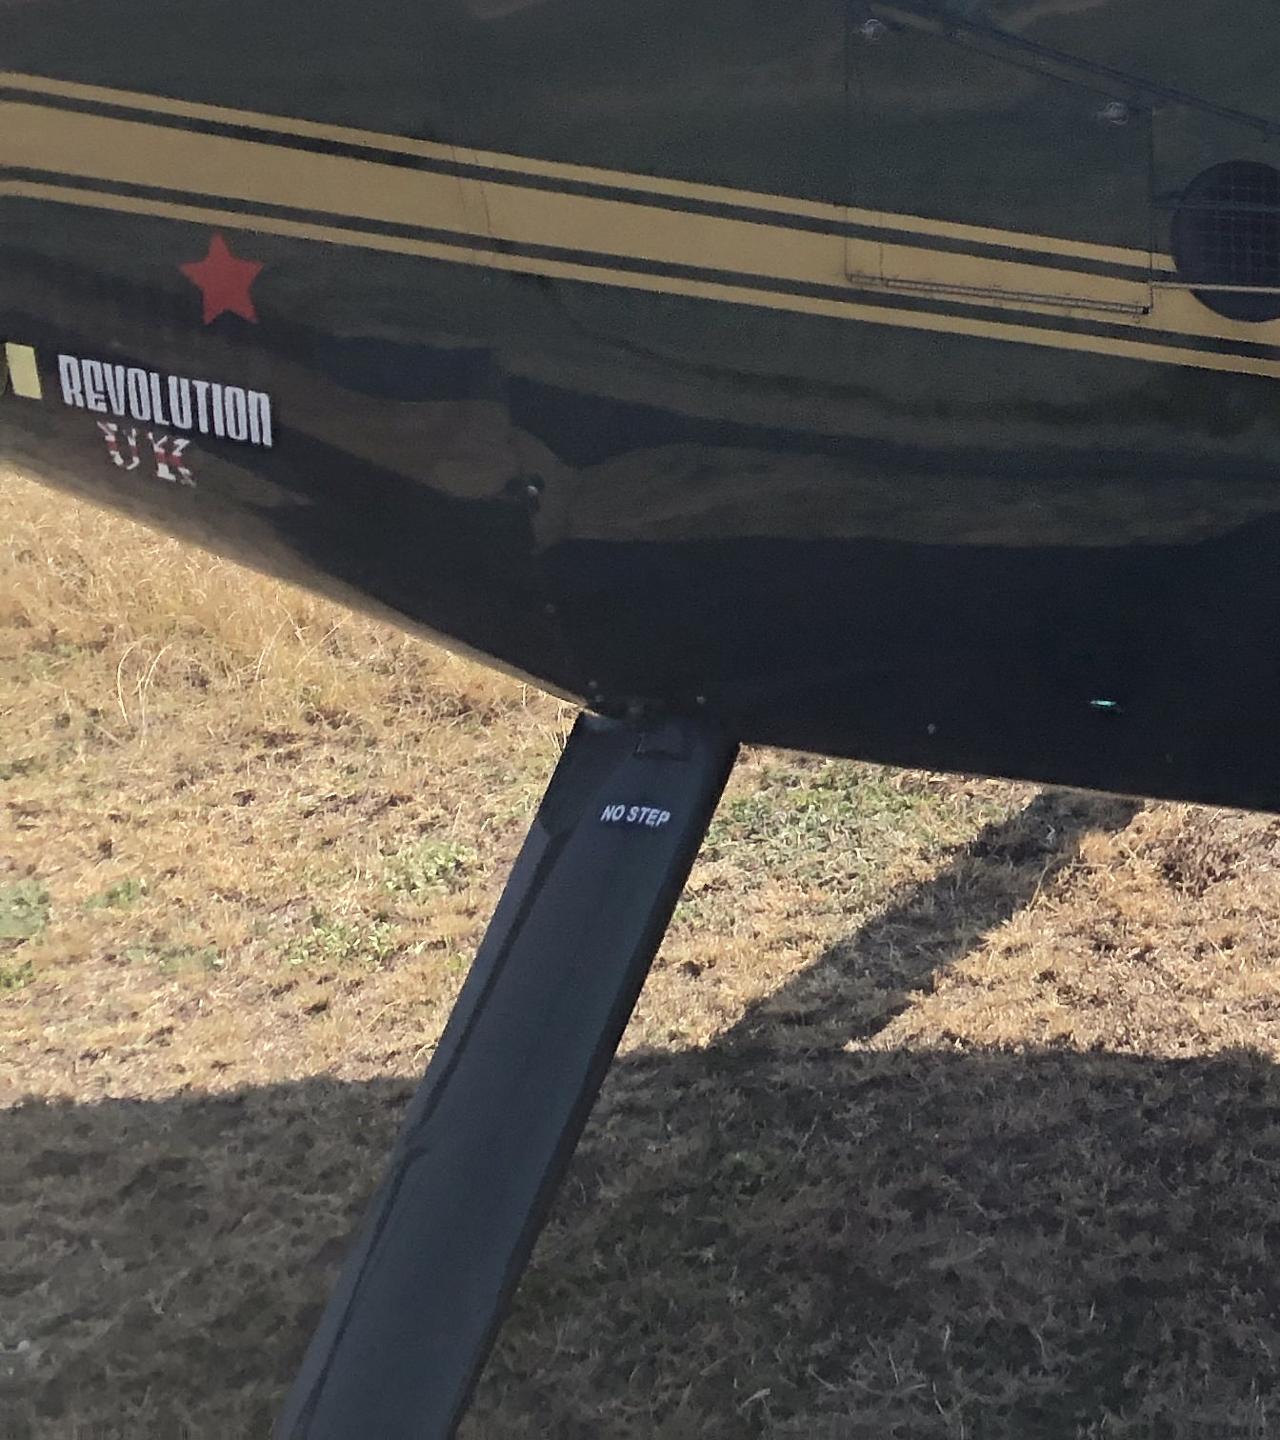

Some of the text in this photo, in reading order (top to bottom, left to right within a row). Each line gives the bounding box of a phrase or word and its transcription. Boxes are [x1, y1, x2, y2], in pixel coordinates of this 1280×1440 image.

[57, 354, 273, 447] REVOLUTION
[600, 804, 671, 828] NO STEP
